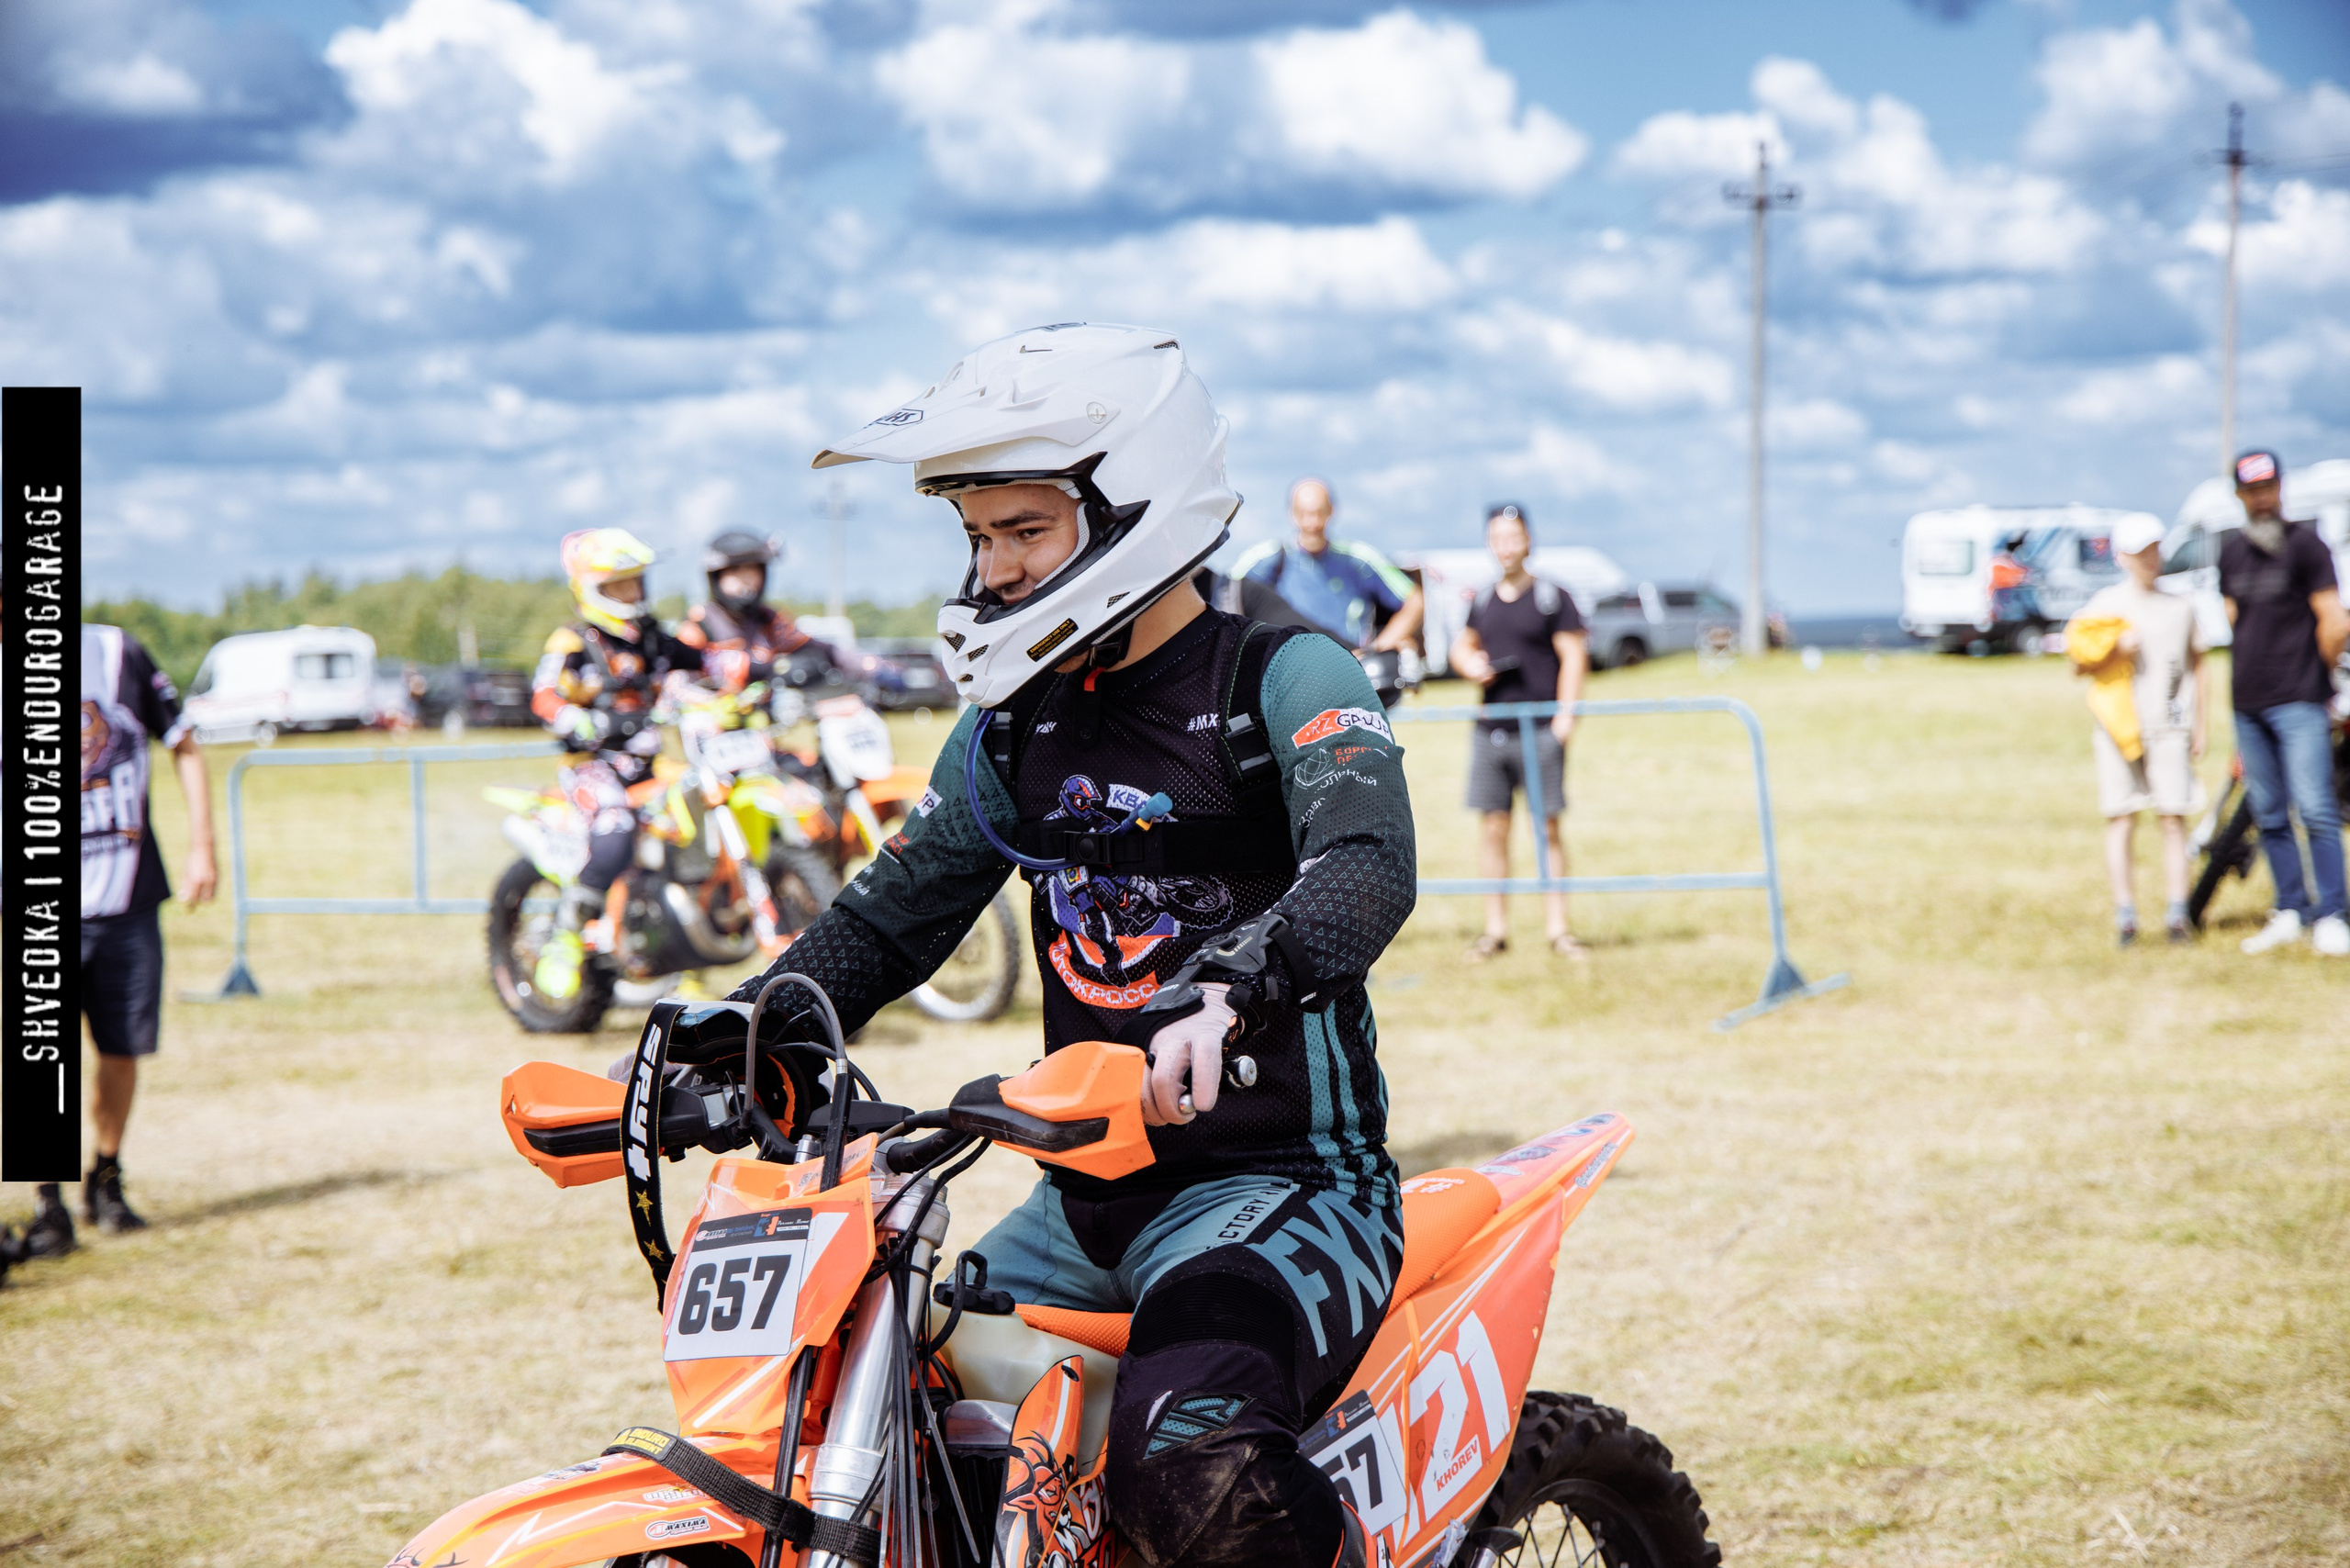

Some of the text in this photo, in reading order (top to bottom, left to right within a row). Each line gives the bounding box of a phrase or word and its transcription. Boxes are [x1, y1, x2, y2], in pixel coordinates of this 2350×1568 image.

[1216, 1198, 1270, 1242] CTORY
[678, 1254, 792, 1336] 657
[1328, 1432, 1383, 1515] 57
[1436, 1439, 1479, 1493] KHOREV
[665, 1518, 706, 1532] MAXIMA
